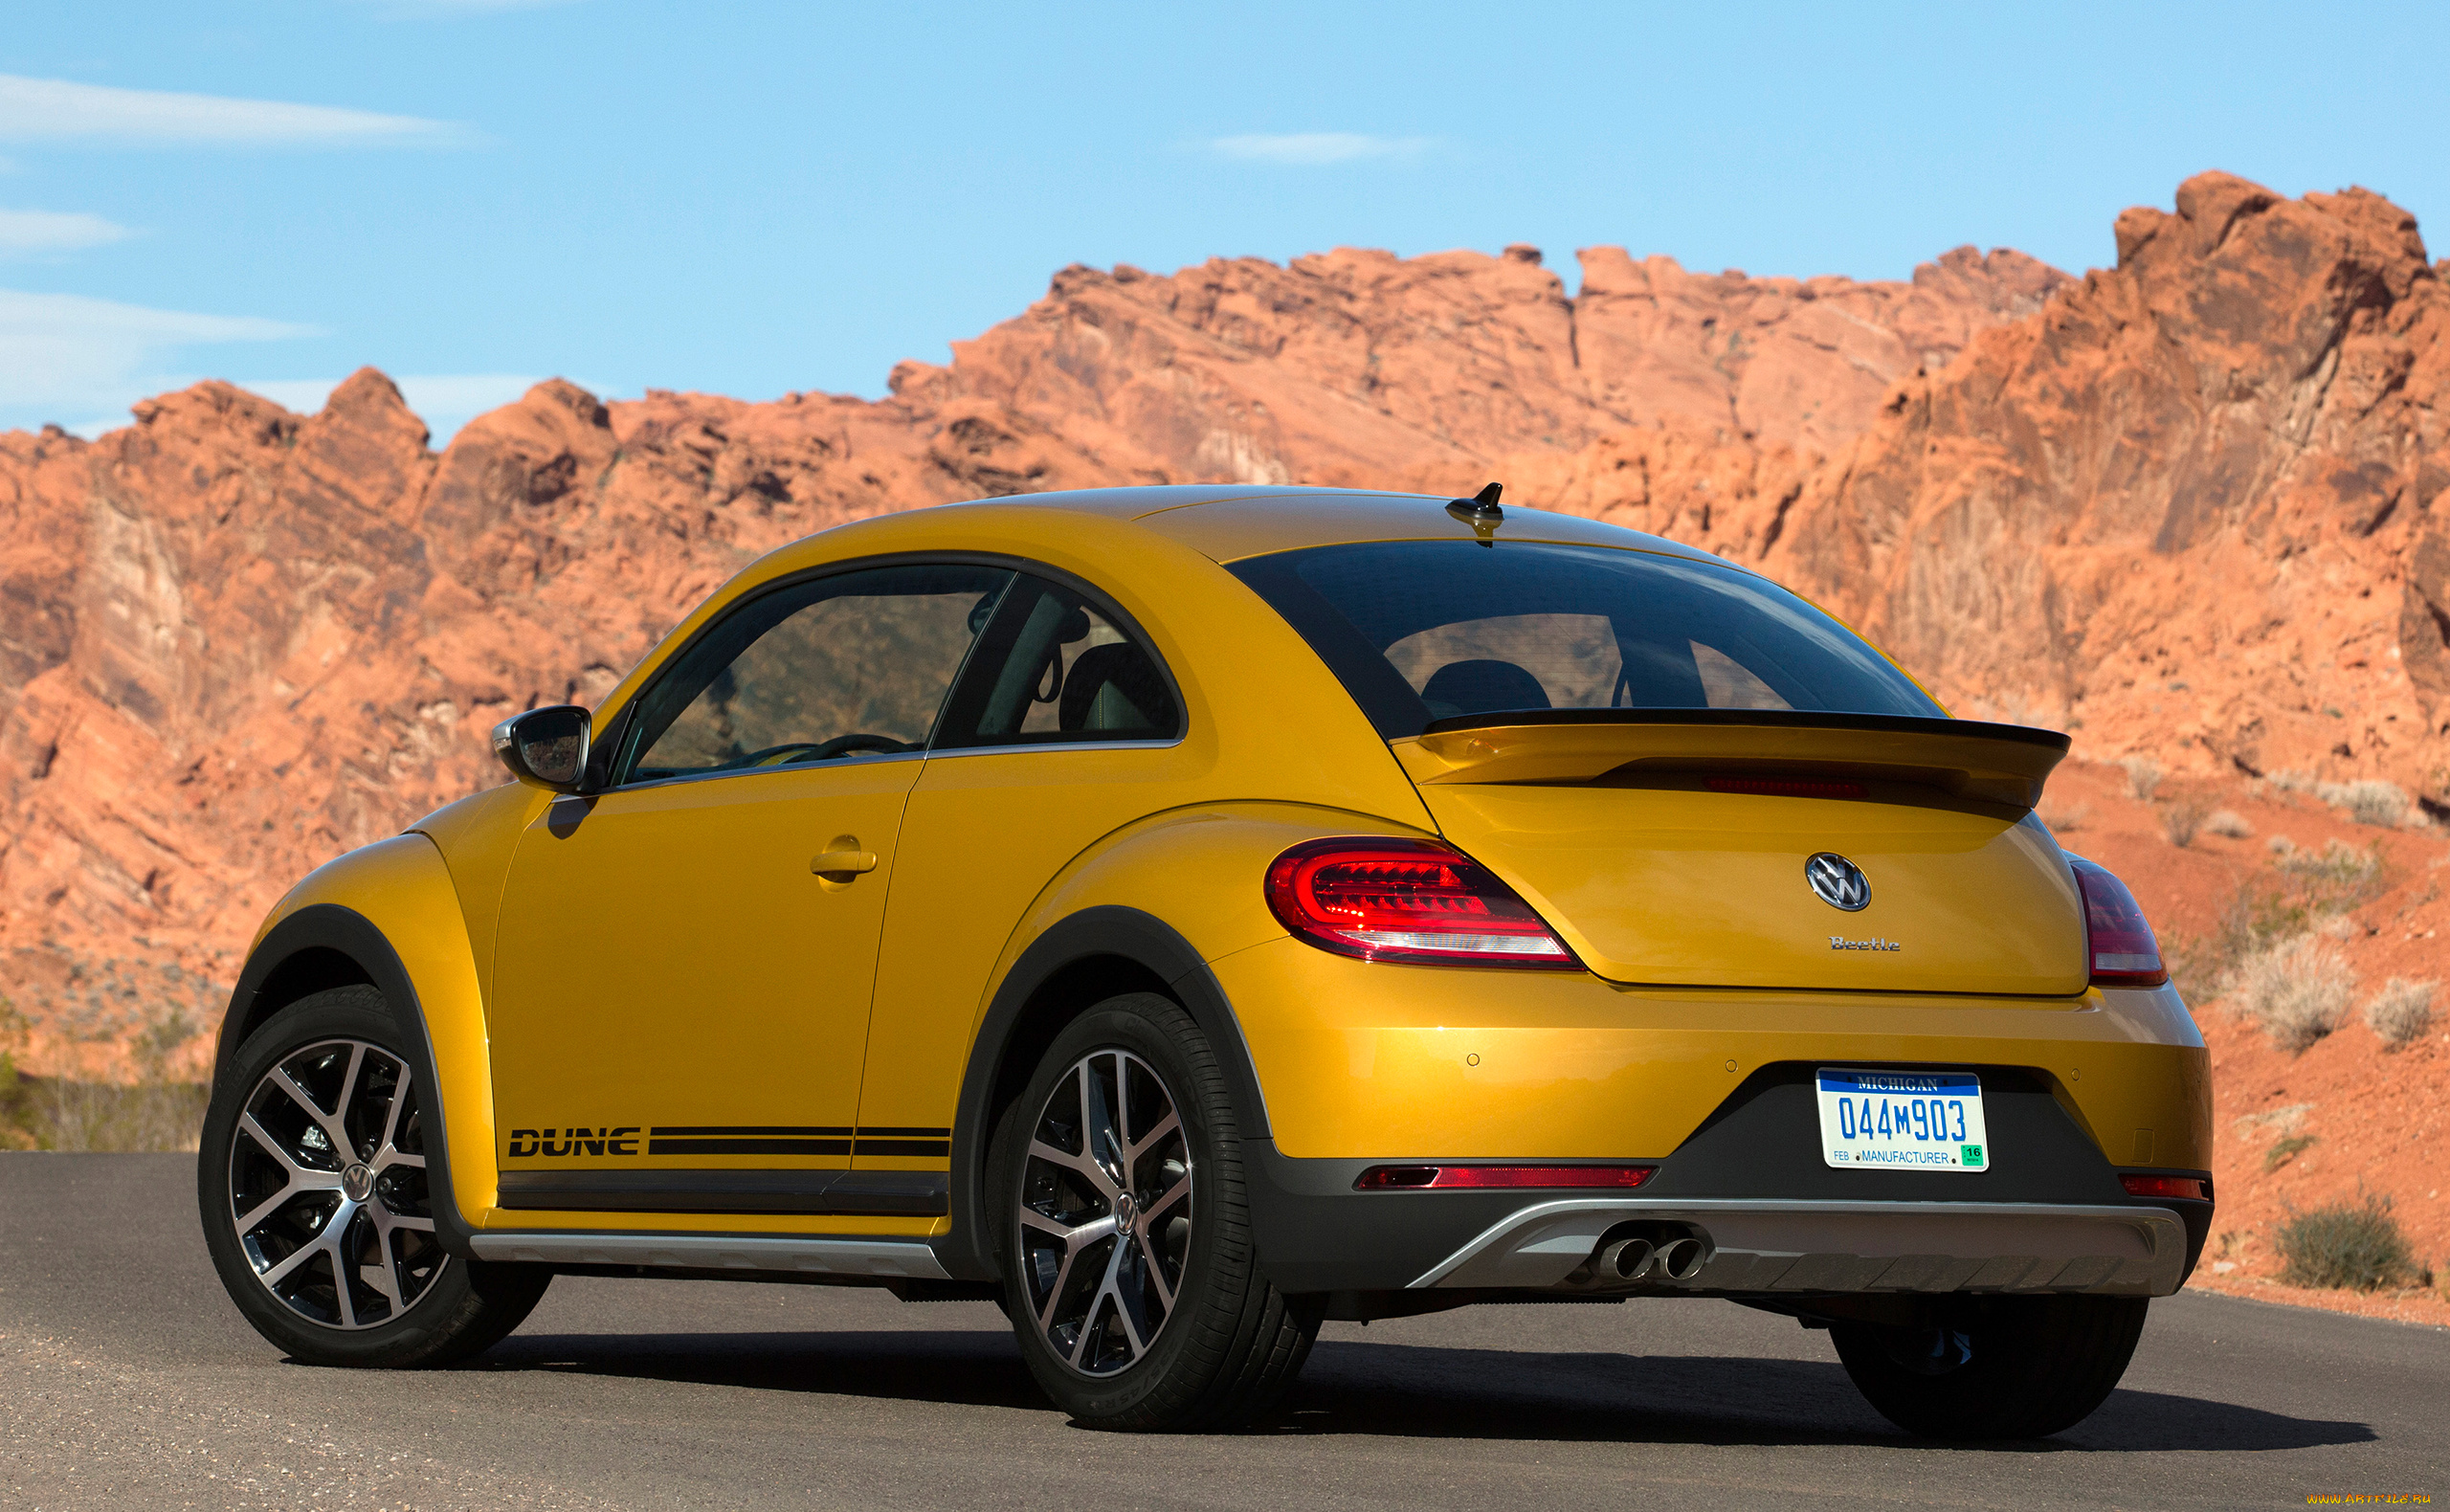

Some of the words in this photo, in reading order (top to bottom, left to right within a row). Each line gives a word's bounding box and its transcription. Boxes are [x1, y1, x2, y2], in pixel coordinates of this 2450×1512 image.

[1806, 853, 1872, 911] VW
[1828, 936, 1901, 951] Beetle
[1858, 1076, 1938, 1092] MICHIGAN
[1838, 1098, 1967, 1142] 044M903
[508, 1127, 641, 1157] DUNE
[1834, 1150, 1849, 1161] FEB
[1861, 1150, 1949, 1164] MANUFACTURER
[1966, 1147, 1981, 1157] 16
